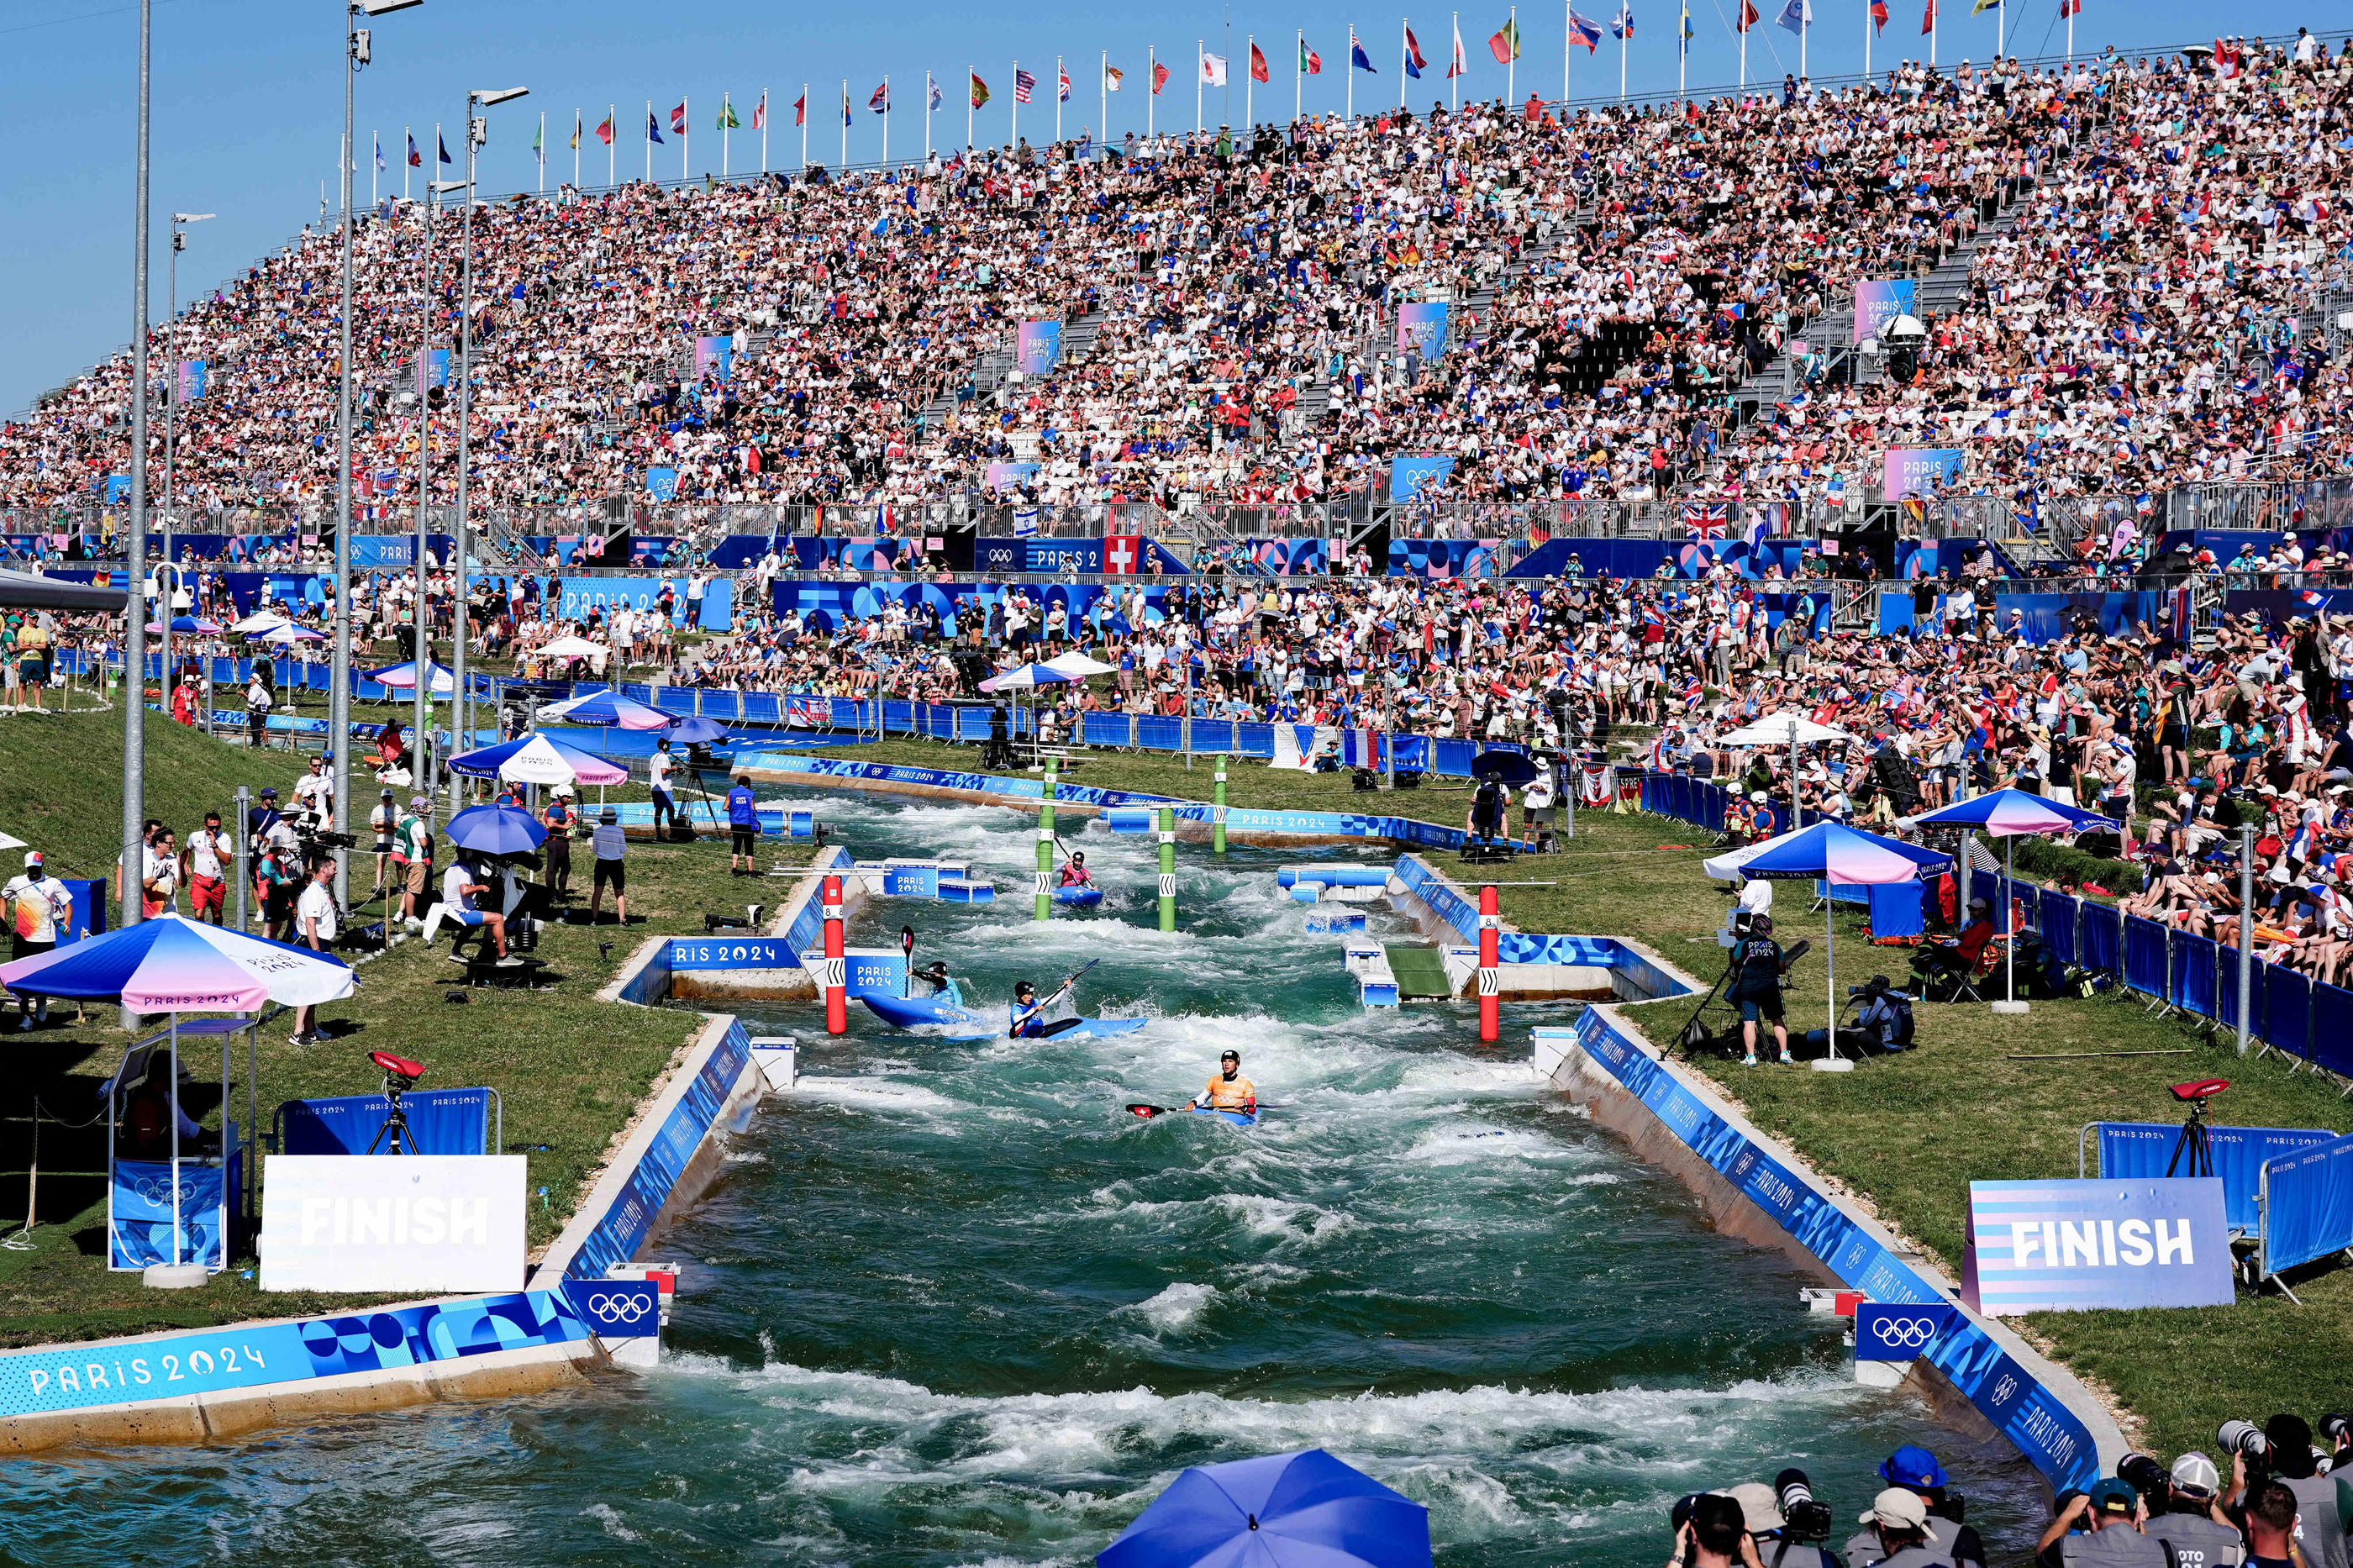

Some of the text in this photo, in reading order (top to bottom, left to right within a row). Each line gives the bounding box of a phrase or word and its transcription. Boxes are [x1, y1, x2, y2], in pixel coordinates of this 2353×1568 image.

[1903, 461, 1942, 475] PARIS
[766, 757, 805, 768] PARIS 2024
[894, 771, 934, 781] PARIS 2024
[1243, 815, 1324, 828] PARIS 2024
[898, 876, 924, 884] PARIS
[898, 884, 924, 892] 2024
[825, 908, 831, 917] 8
[1486, 918, 1492, 926] 8
[719, 945, 776, 962] 2024
[857, 966, 892, 976] PARIS
[857, 976, 892, 987] 2024
[145, 994, 240, 1007] PARIS 2024
[459, 1097, 481, 1105] 2024
[365, 1102, 388, 1112] PARIS
[2108, 1130, 2164, 1140] PARIS 2024
[2218, 1135, 2244, 1144] 2024
[2266, 1137, 2295, 1145] PARIS
[1755, 1169, 1796, 1211] PARIS 2024
[304, 1196, 490, 1245] FINISH
[2010, 1218, 2195, 1267] FINISH
[1869, 1265, 1901, 1301] PARIS
[29, 1344, 266, 1397] PARIS 2024
[2022, 1405, 2077, 1470] PARIS 2024
